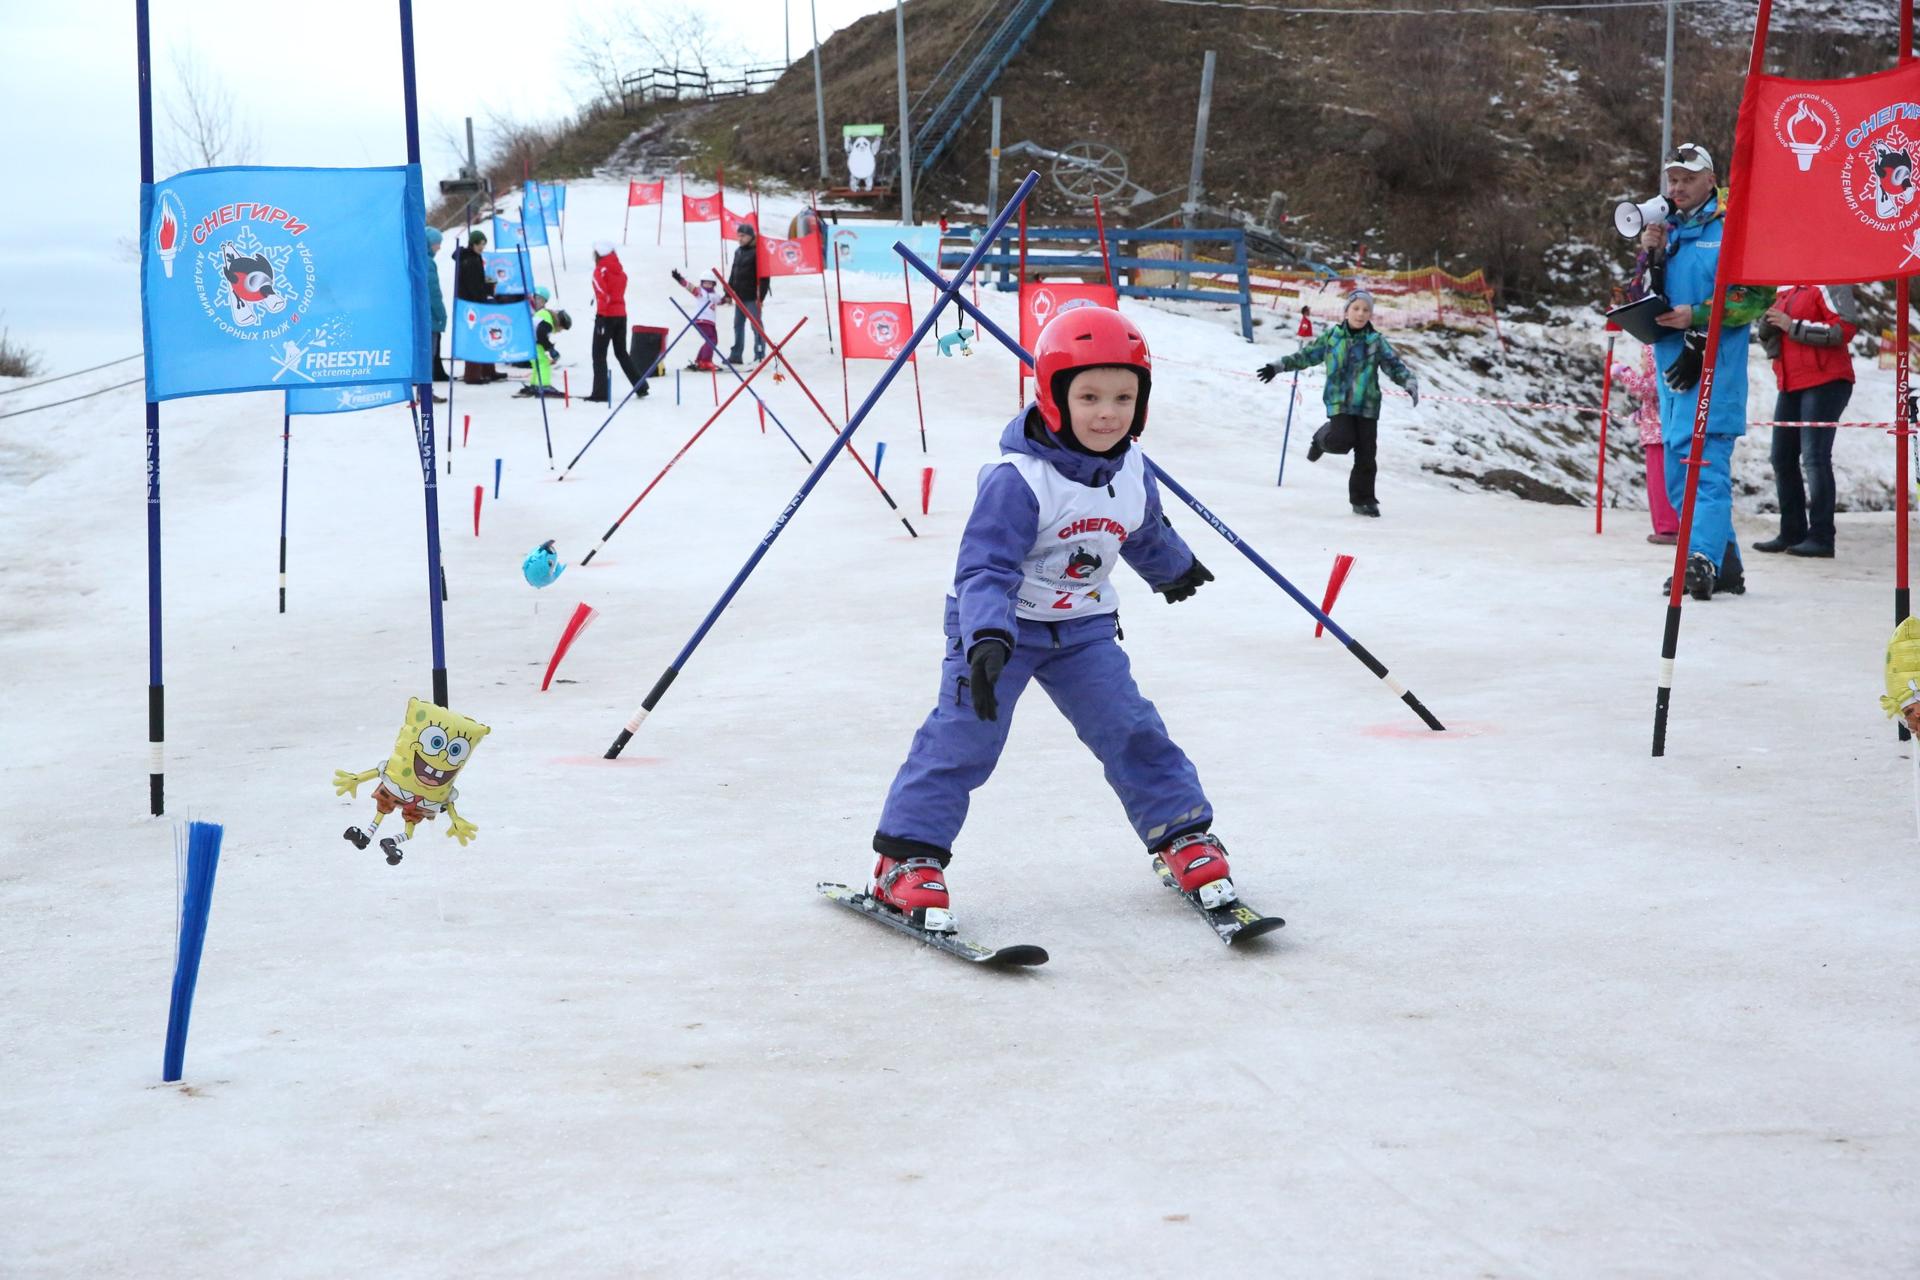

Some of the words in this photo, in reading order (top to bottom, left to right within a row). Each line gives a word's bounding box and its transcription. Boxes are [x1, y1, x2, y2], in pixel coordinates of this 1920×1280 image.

[192, 202, 309, 245] СНЕГИРИ
[1855, 210, 1896, 231] ГОРНЫХ
[194, 251, 215, 316] АКАДЕМИЯ
[213, 316, 259, 340] ГОРНЫХ
[262, 320, 291, 340] ЛЫЖ
[296, 241, 316, 314] СНОУБОРДА
[306, 350, 391, 369] FREESTYLE
[311, 368, 351, 378] extreme
[351, 367, 372, 378] park
[1697, 374, 1712, 433] LISKI
[1898, 357, 1908, 416] LISKI
[422, 419, 432, 482] LISKI
